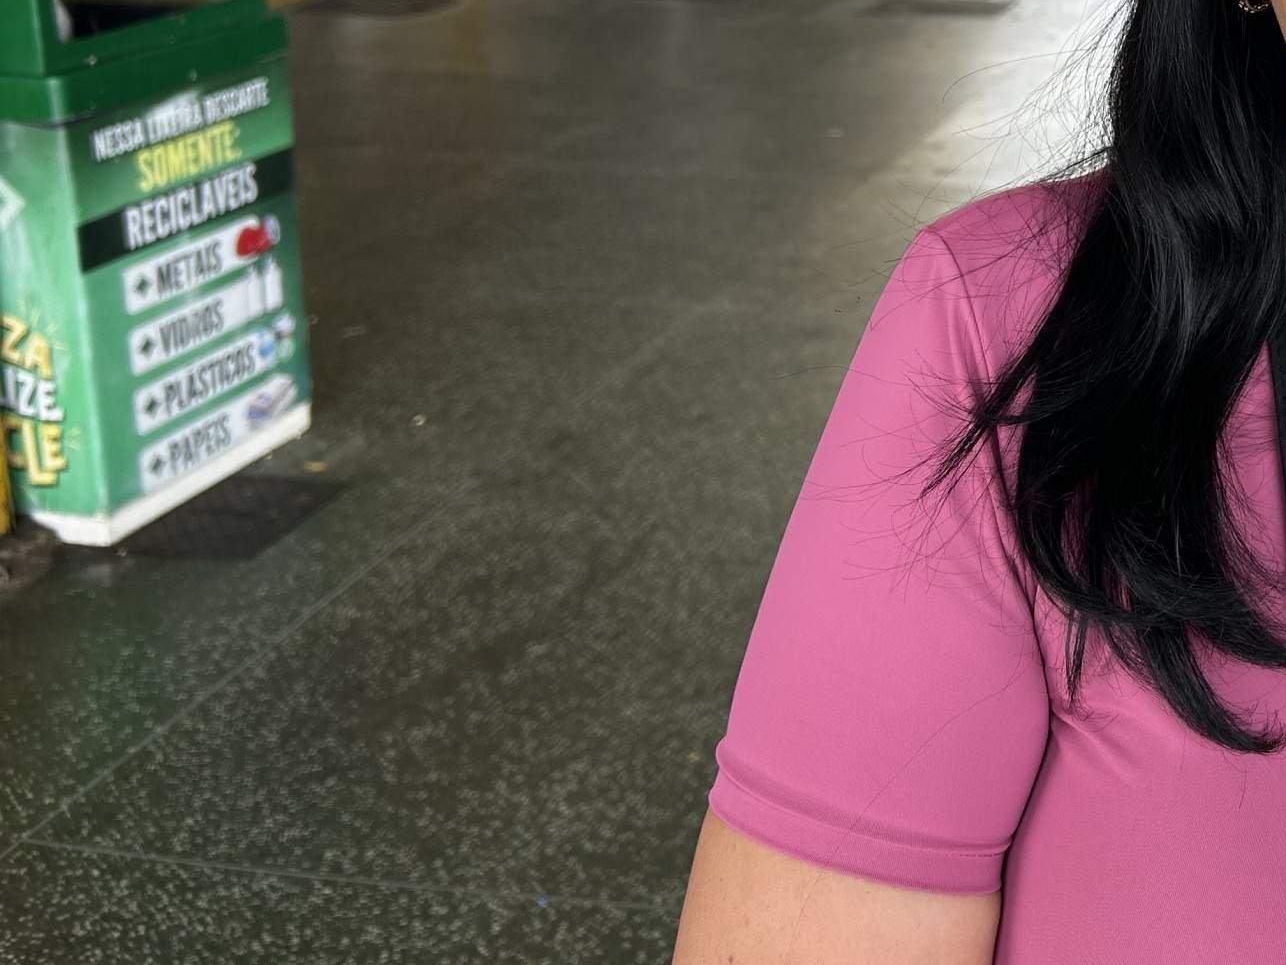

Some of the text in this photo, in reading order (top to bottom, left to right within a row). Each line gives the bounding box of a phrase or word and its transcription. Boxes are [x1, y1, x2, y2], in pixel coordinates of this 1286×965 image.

[92, 118, 146, 163] NESSA
[203, 76, 270, 125] DESCARTE
[136, 119, 242, 193] SOMENTE
[156, 239, 223, 295] METAIS
[160, 299, 225, 356] VIDROS
[0, 366, 64, 423] IZE
[168, 412, 232, 476] PAPEIS
